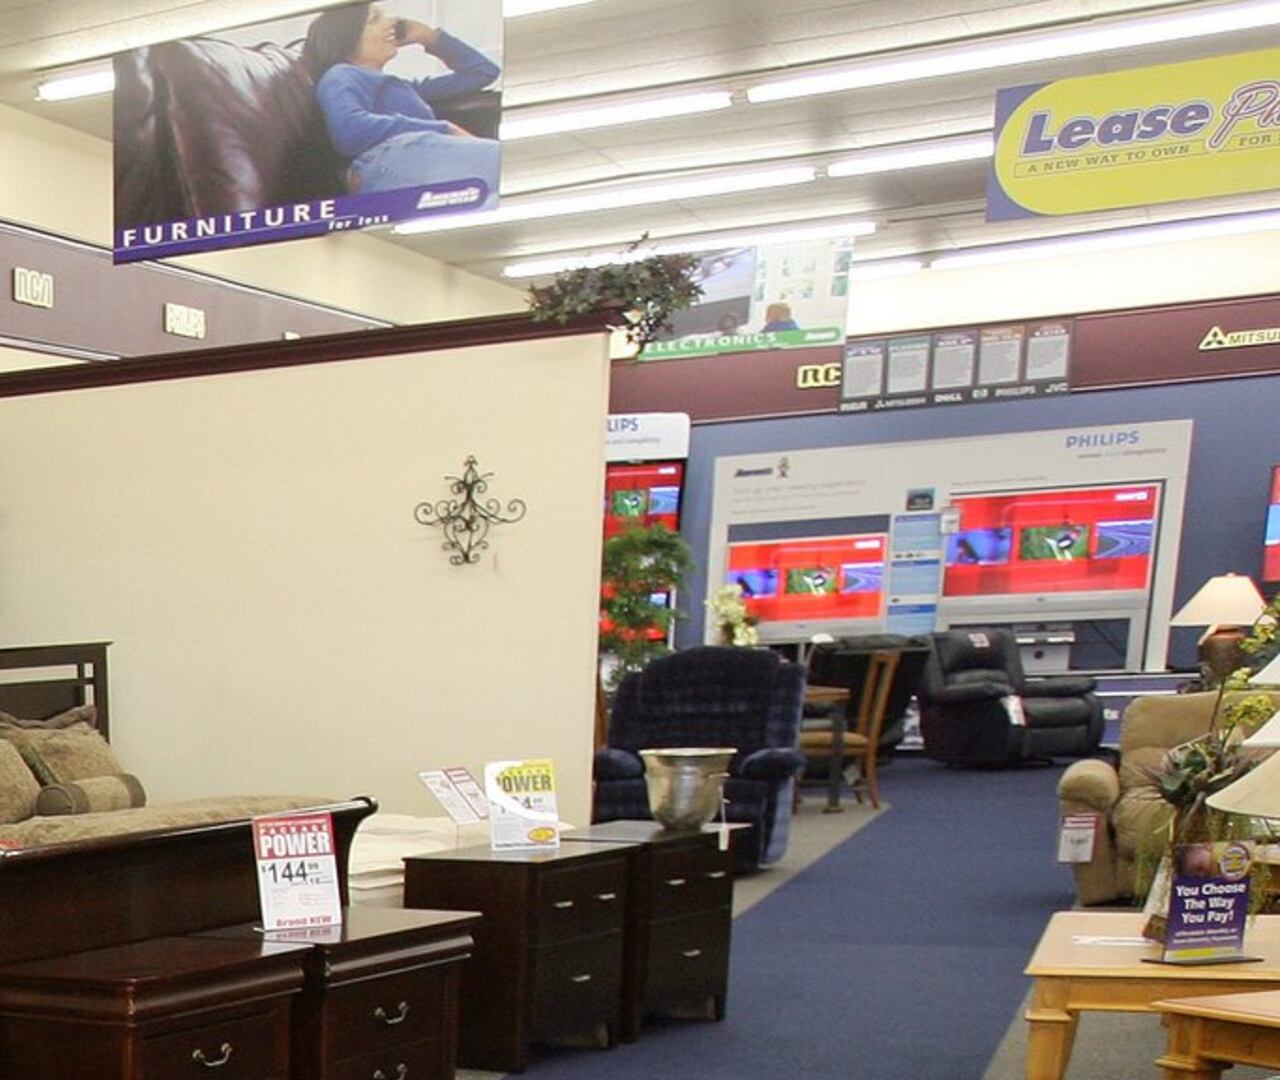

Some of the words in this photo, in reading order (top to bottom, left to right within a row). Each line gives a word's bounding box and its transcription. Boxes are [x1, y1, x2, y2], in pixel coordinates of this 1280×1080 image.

[1022, 103, 1211, 155] Lease
[1028, 164, 1037, 173] A
[1044, 161, 1079, 172] NEW
[1087, 154, 1120, 166] WAY
[1126, 150, 1146, 161] TO
[1152, 144, 1190, 157] OWN
[1240, 134, 1273, 147] FOR
[122, 199, 337, 248] FURNITURE
[1229, 331, 1280, 345] MITSU
[799, 365, 841, 386] RC
[607, 417, 639, 432] LIPS
[1065, 430, 1140, 448] PHILIPS
[260, 831, 331, 858] POWER
[1176, 885, 1199, 897] You
[1202, 883, 1246, 895] Choose
[1184, 899, 1206, 910] The
[1209, 897, 1235, 911] Way
[1182, 912, 1205, 924] You
[1207, 910, 1234, 924] Pay!
